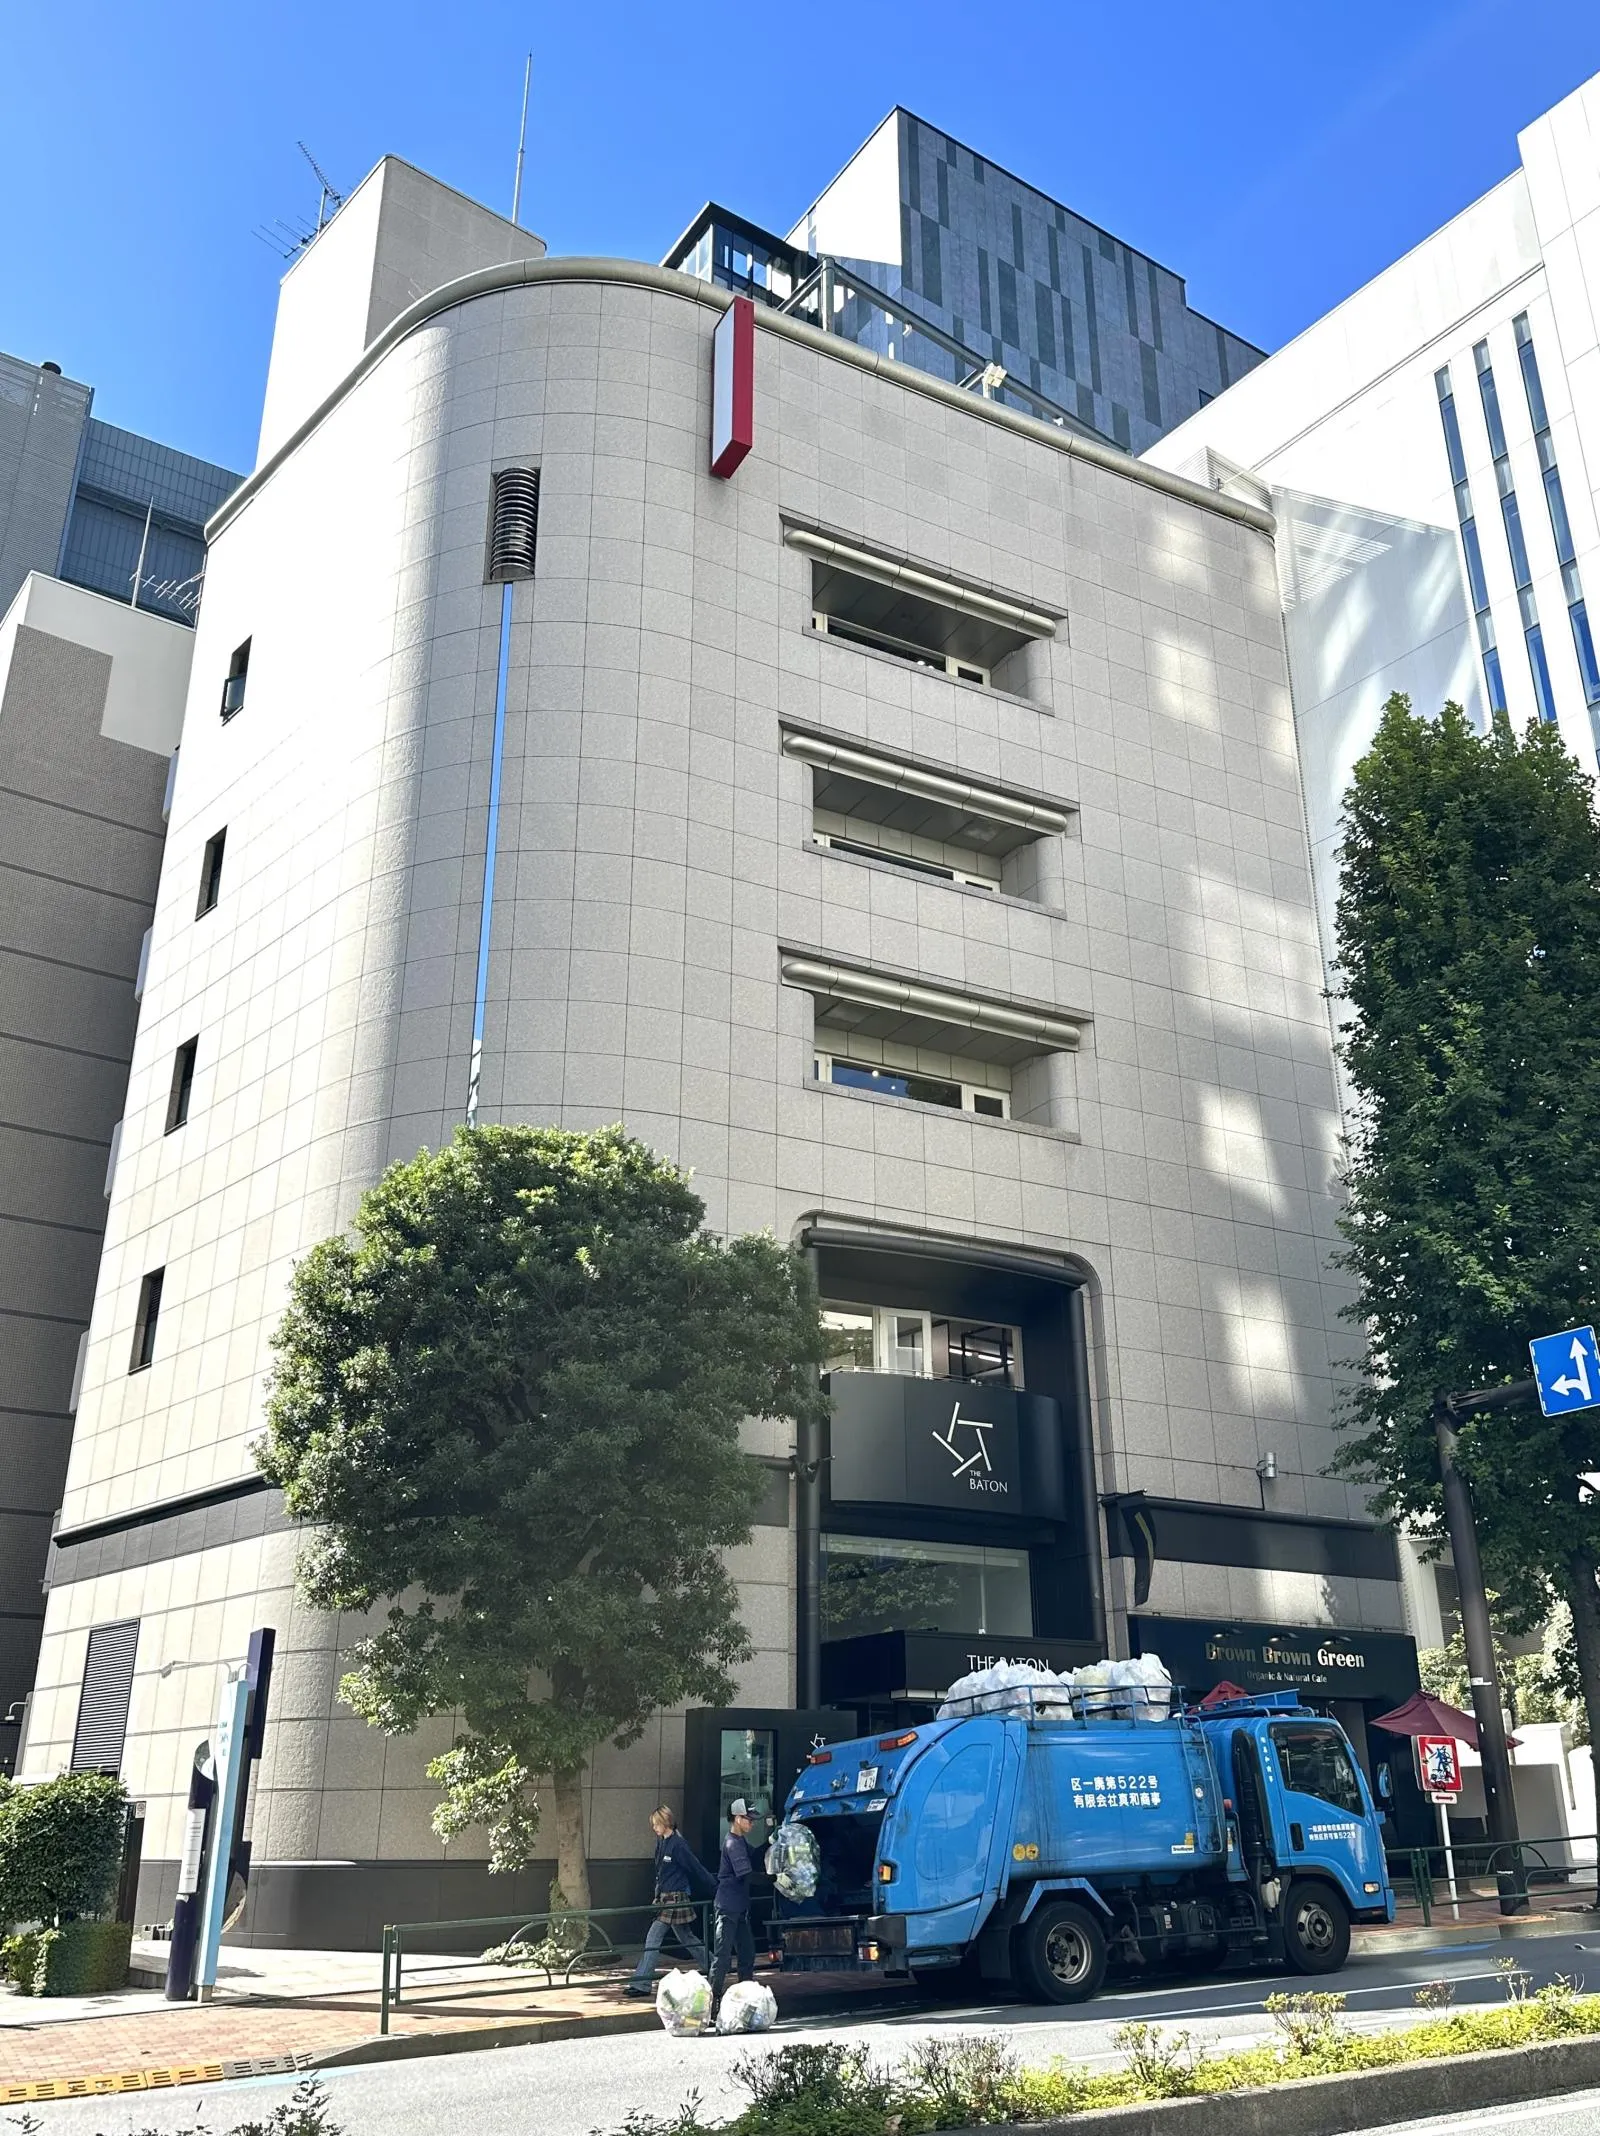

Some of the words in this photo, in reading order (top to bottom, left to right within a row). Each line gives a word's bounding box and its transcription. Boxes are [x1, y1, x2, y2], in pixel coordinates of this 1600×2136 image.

[969, 1478, 1008, 1493] BATON
[966, 1655, 995, 1670] THE
[1205, 1642, 1256, 1662] Brown
[1262, 1646, 1312, 1666] Brown
[1317, 1648, 1365, 1668] Green
[1247, 1671, 1276, 1681] Organic
[1276, 1672, 1282, 1681] &
[1283, 1673, 1310, 1682] Natural
[1071, 1775, 1158, 1791] 区一廃第522号
[1073, 1792, 1161, 1808] 有限会社真和商事
